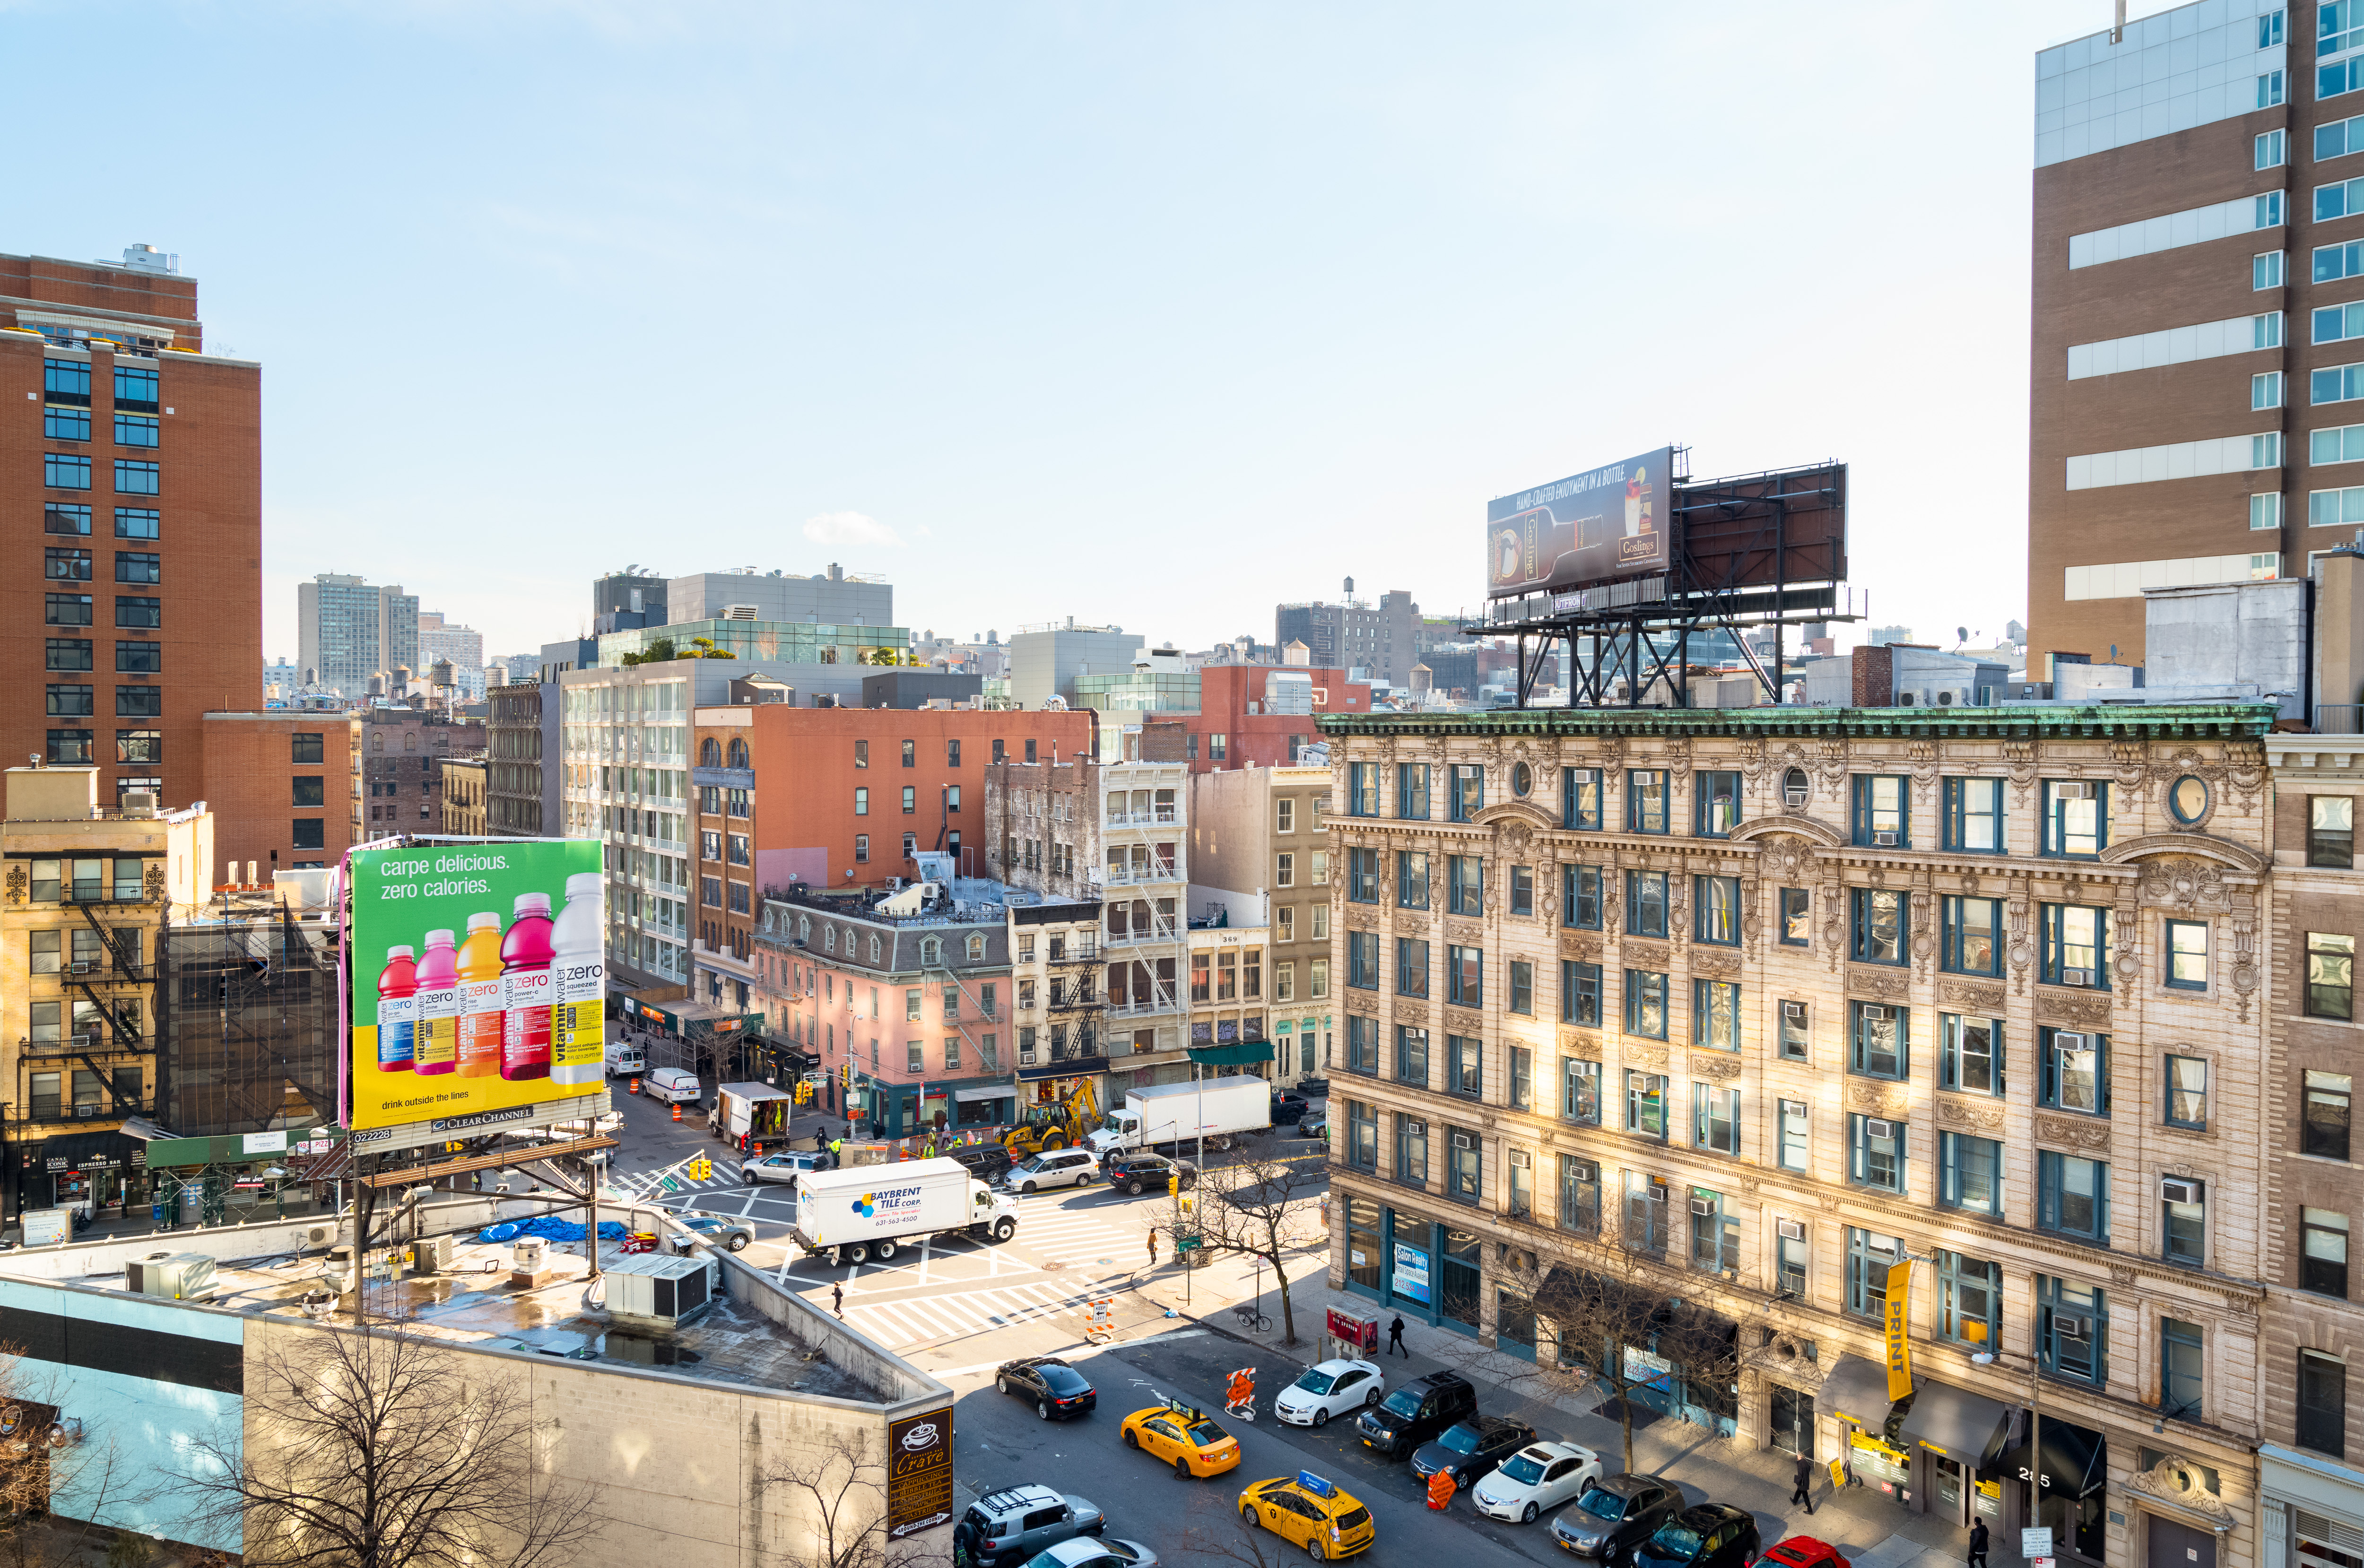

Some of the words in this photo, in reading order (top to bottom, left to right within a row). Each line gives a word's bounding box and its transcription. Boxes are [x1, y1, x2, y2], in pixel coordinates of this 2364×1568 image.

[1516, 485, 1555, 511] HAND-CRAFTED
[1556, 475, 1589, 500] ENJOYMENT
[1589, 472, 1596, 490] IN
[1597, 470, 1601, 488] A
[1602, 464, 1625, 486] BOTTLE.
[1527, 519, 1535, 574] Goslings
[1623, 540, 1654, 554] Goslings
[1552, 596, 1585, 610] OUTFRONT
[381, 860, 429, 878] carpe
[436, 854, 509, 873] delicious.
[381, 884, 417, 899] zero
[424, 877, 491, 897] calories.
[567, 964, 602, 980] zero
[514, 975, 548, 989] zero
[567, 980, 597, 989] squeezed
[468, 984, 497, 997] zero
[388, 1000, 411, 1010] zero
[426, 992, 453, 1004] zero
[505, 977, 513, 1062] vitaminwater
[556, 968, 565, 1062] vitaminwater
[459, 987, 467, 1061] vitaminwater
[382, 1099, 403, 1110] drink
[405, 1096, 434, 1107] outside
[451, 1091, 469, 1100] lines
[666, 1180, 677, 1191] Broadway
[870, 1187, 921, 1201] BAYBRENT
[881, 1198, 900, 1209] TILE
[876, 1216, 917, 1226] 631-563-4500
[1398, 1247, 1411, 1262] Salon
[1412, 1253, 1427, 1270] Realty
[1396, 1263, 1404, 1273] Retail
[1405, 1267, 1414, 1277] Space
[1414, 1271, 1428, 1282] Available
[1395, 1278, 1428, 1298] 212.534.3131
[1341, 1321, 1357, 1332] SPARROW
[1891, 1301, 1903, 1374] PRINT
[1842, 1414, 1861, 1424] bestype
[912, 1451, 932, 1459] ESPRESSO
[1927, 1443, 1947, 1454] bestype
[897, 1452, 944, 1474] Crave
[899, 1471, 943, 1489] CAPPUCCINO
[899, 1483, 927, 1497] BUBBLE
[1982, 1484, 1999, 1492] PRINTED
[1983, 1489, 1999, 1498] MATTER
[899, 1487, 942, 1504] SMOOTHIES
[898, 1495, 944, 1513] SANDWICHES
[905, 1505, 937, 1519] PASTRIES
[898, 1523, 916, 1534] AROUND
[926, 1515, 943, 1525] CORNER
